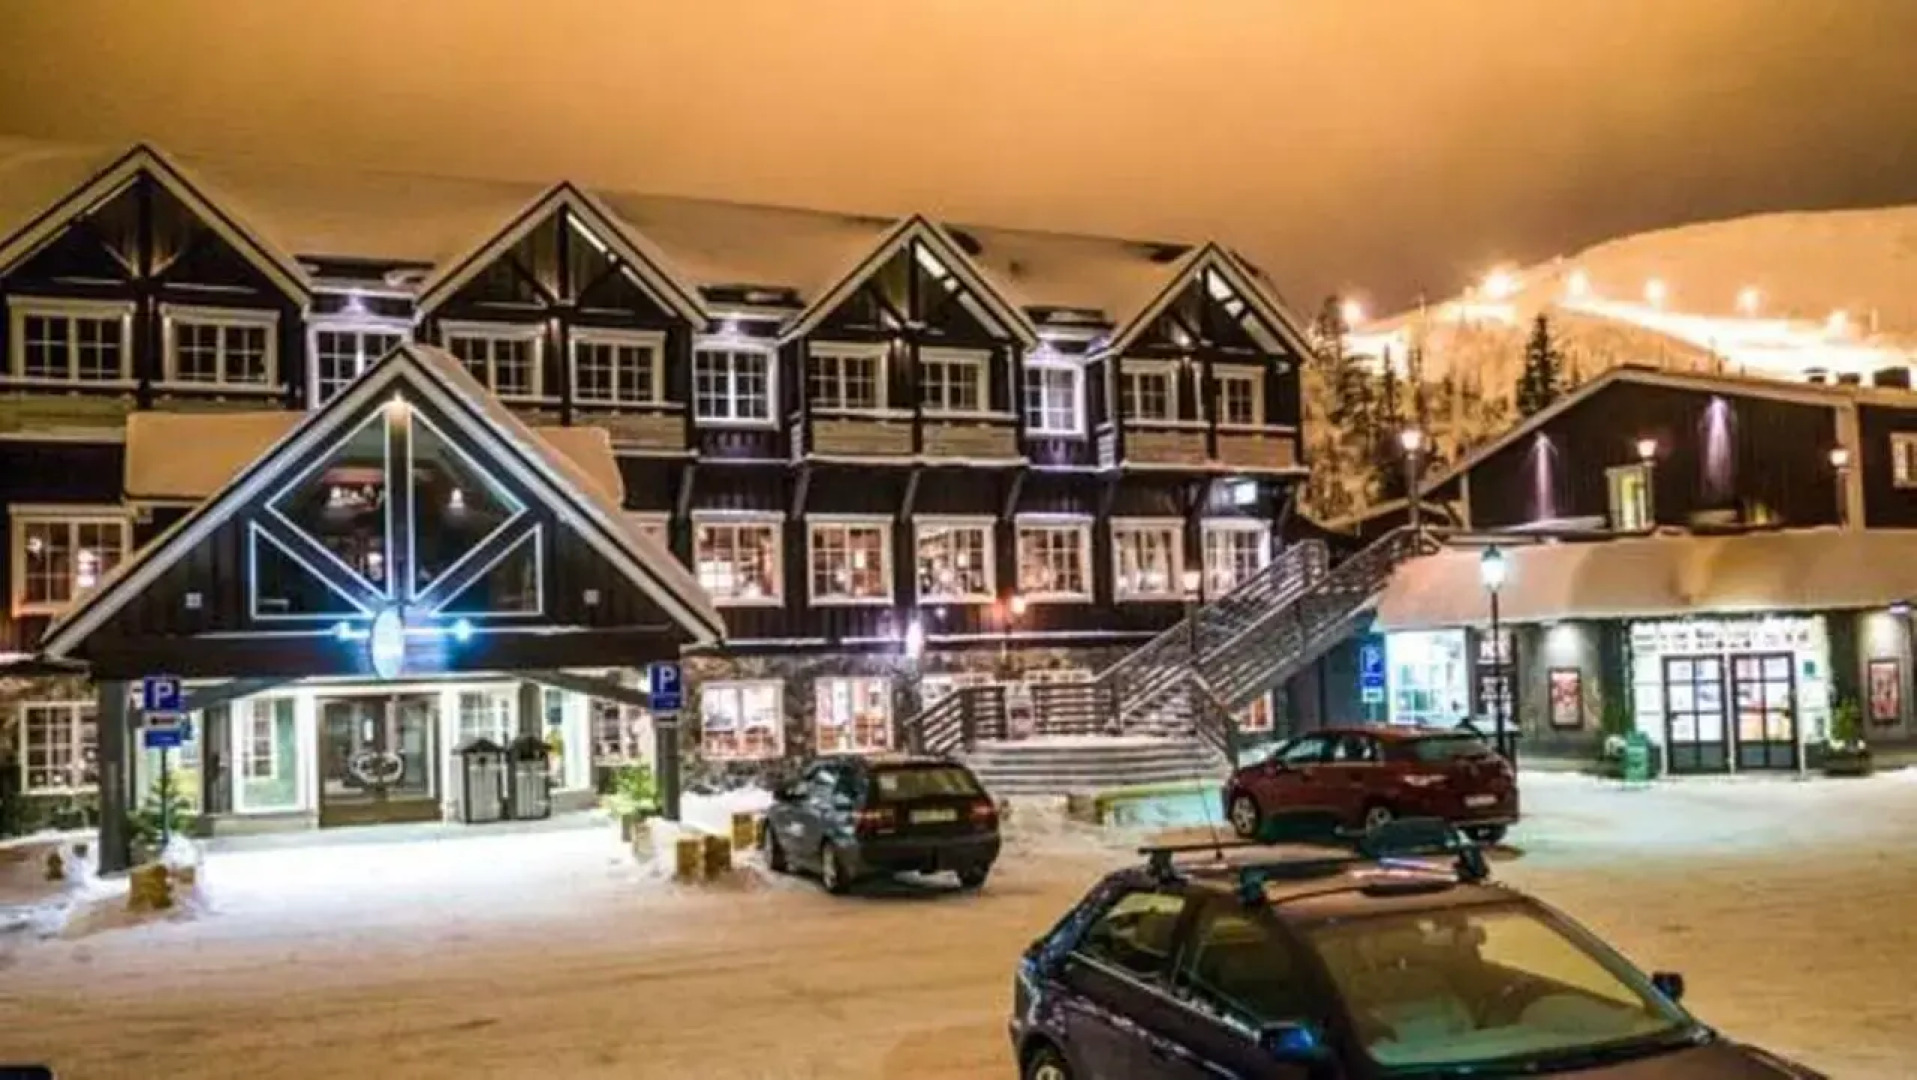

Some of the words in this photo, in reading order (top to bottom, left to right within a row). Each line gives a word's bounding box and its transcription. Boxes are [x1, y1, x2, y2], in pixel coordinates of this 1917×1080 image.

[1366, 648, 1380, 671] P
[659, 665, 676, 693] P
[154, 682, 172, 707] P
